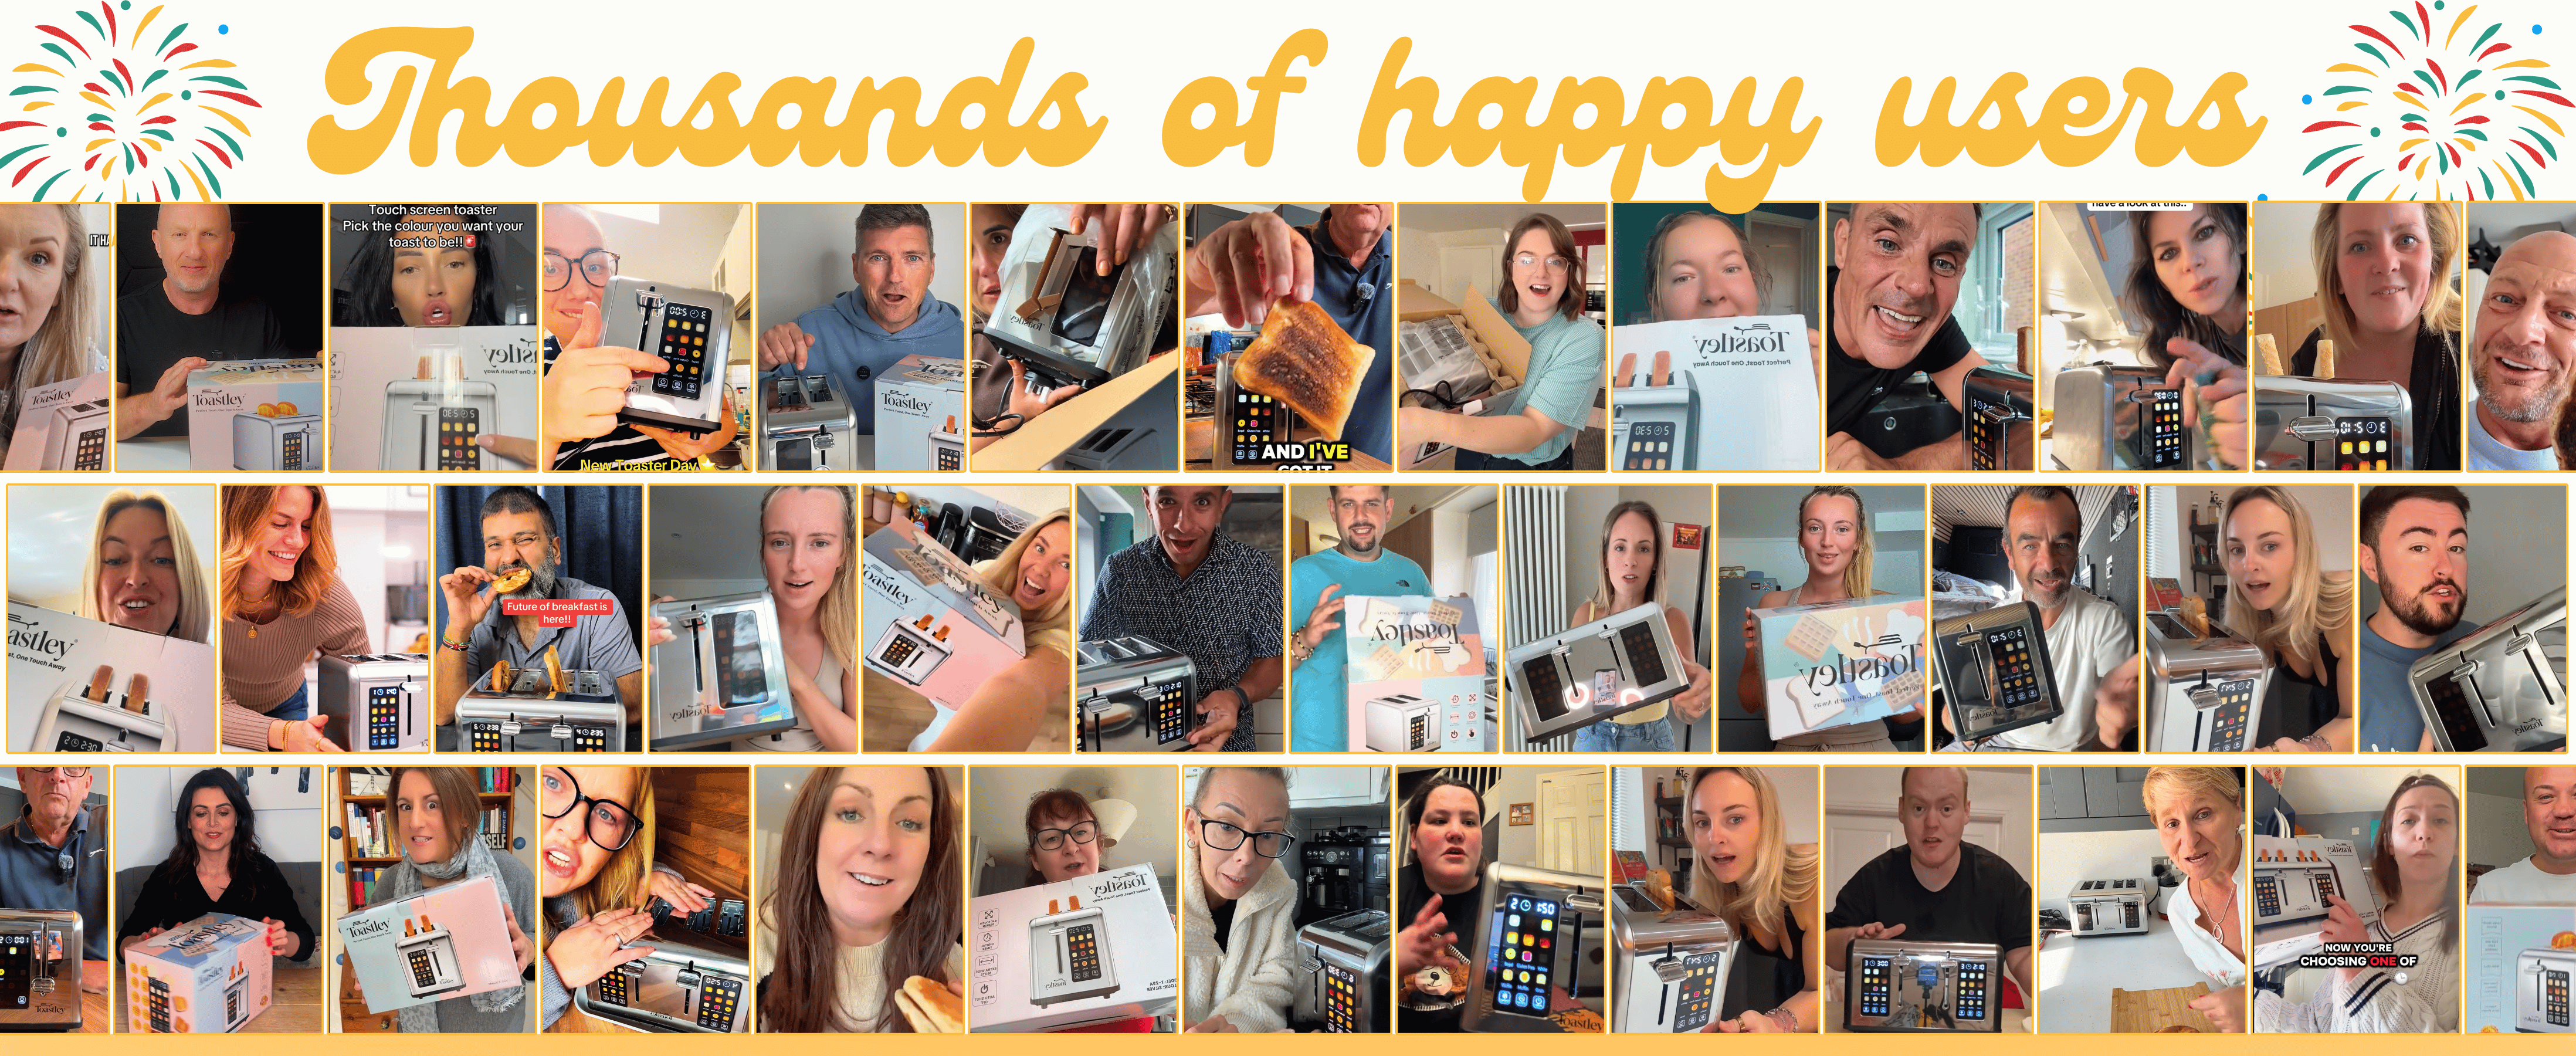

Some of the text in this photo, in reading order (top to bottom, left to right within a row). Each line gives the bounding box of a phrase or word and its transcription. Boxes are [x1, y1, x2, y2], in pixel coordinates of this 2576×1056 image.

[32, 390, 74, 405] Toastley
[192, 393, 245, 408] Toastley
[882, 392, 933, 414] Toastley
[913, 543, 1005, 613] Toastley
[964, 595, 982, 611] Touch
[984, 610, 998, 621] Away
[1371, 620, 1465, 645] Toastley
[29, 656, 48, 666] Touch
[48, 662, 66, 672] Away
[1171, 682, 1181, 690] 2:10
[65, 736, 97, 752] 2 2:30
[168, 920, 236, 950] Toastley
[346, 918, 391, 939] Toastley
[36, 1006, 66, 1014] Toastley
[1558, 1013, 1604, 1033] Toastley
